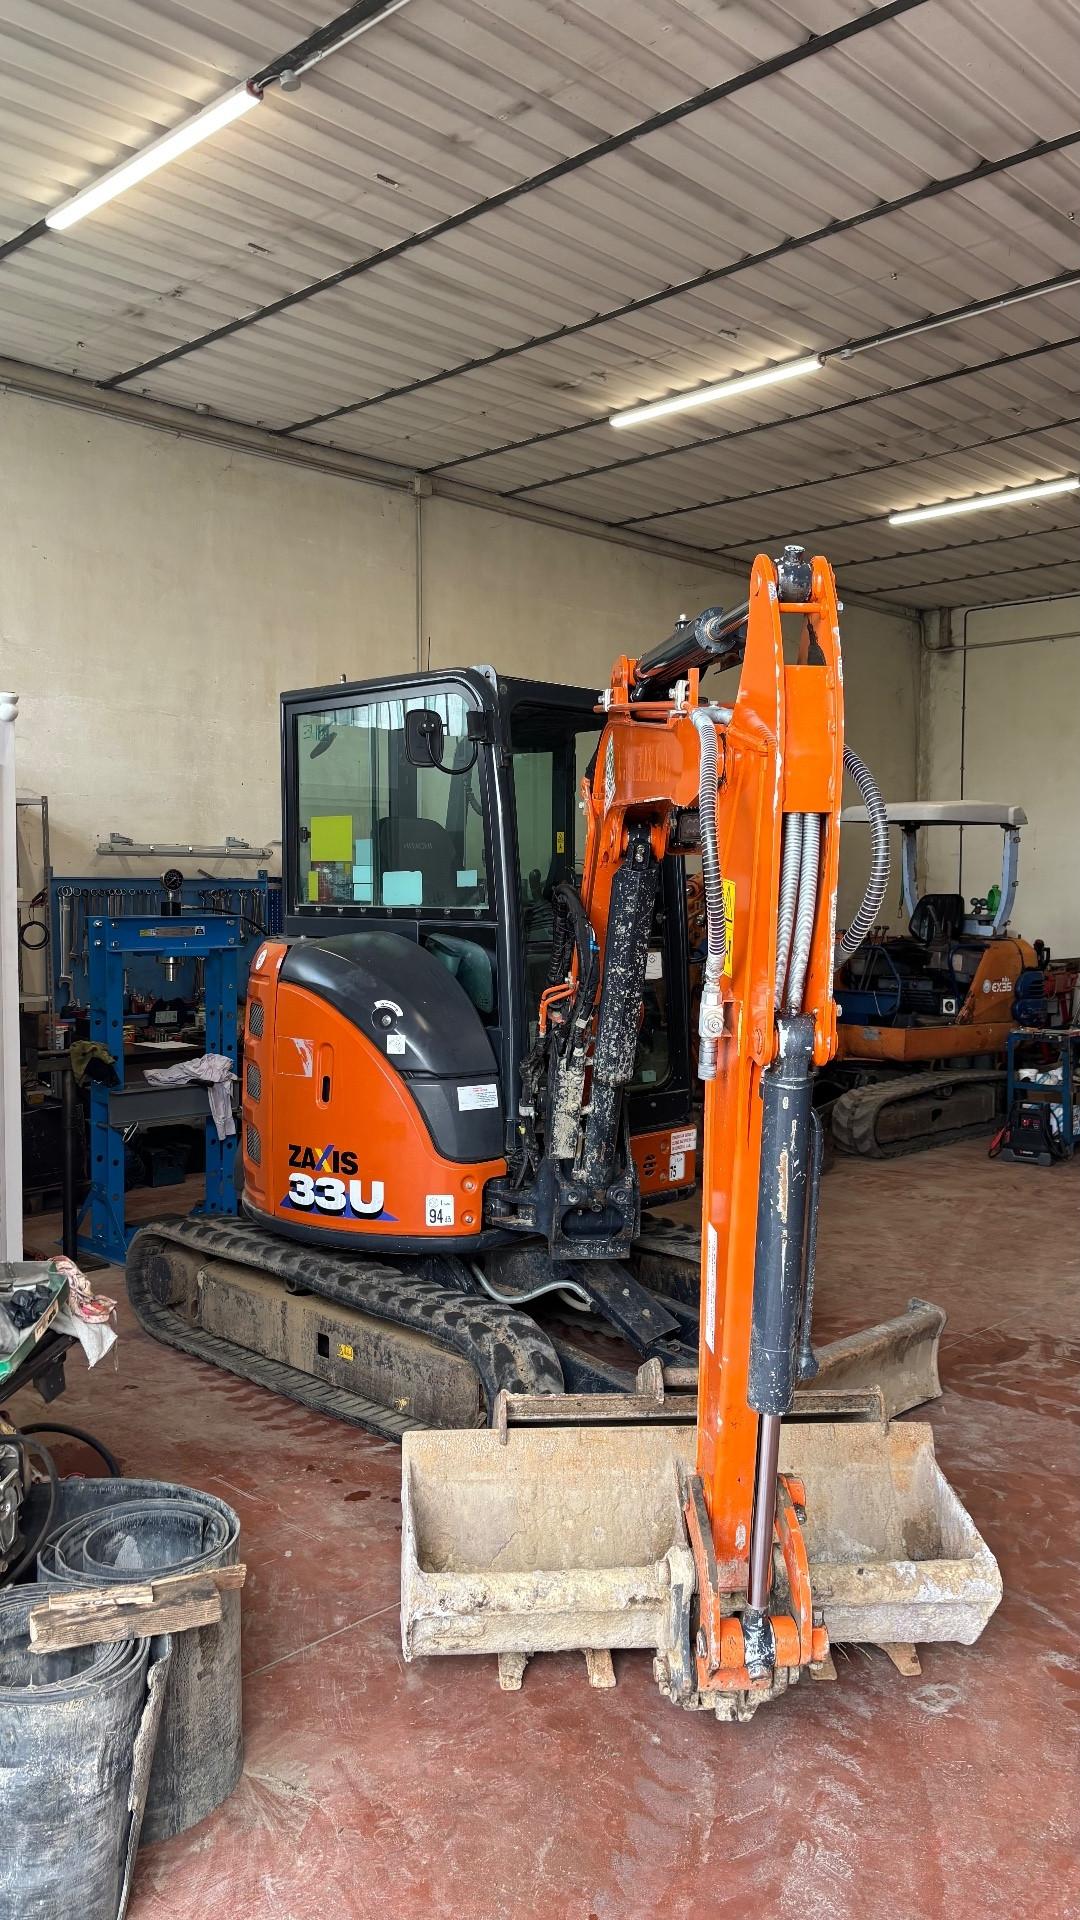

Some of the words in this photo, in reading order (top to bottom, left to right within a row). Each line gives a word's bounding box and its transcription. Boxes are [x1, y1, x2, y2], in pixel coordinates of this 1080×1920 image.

[288, 1143, 359, 1175] ZAXIS
[288, 1173, 385, 1216] 33U
[429, 1208, 443, 1224] 94
